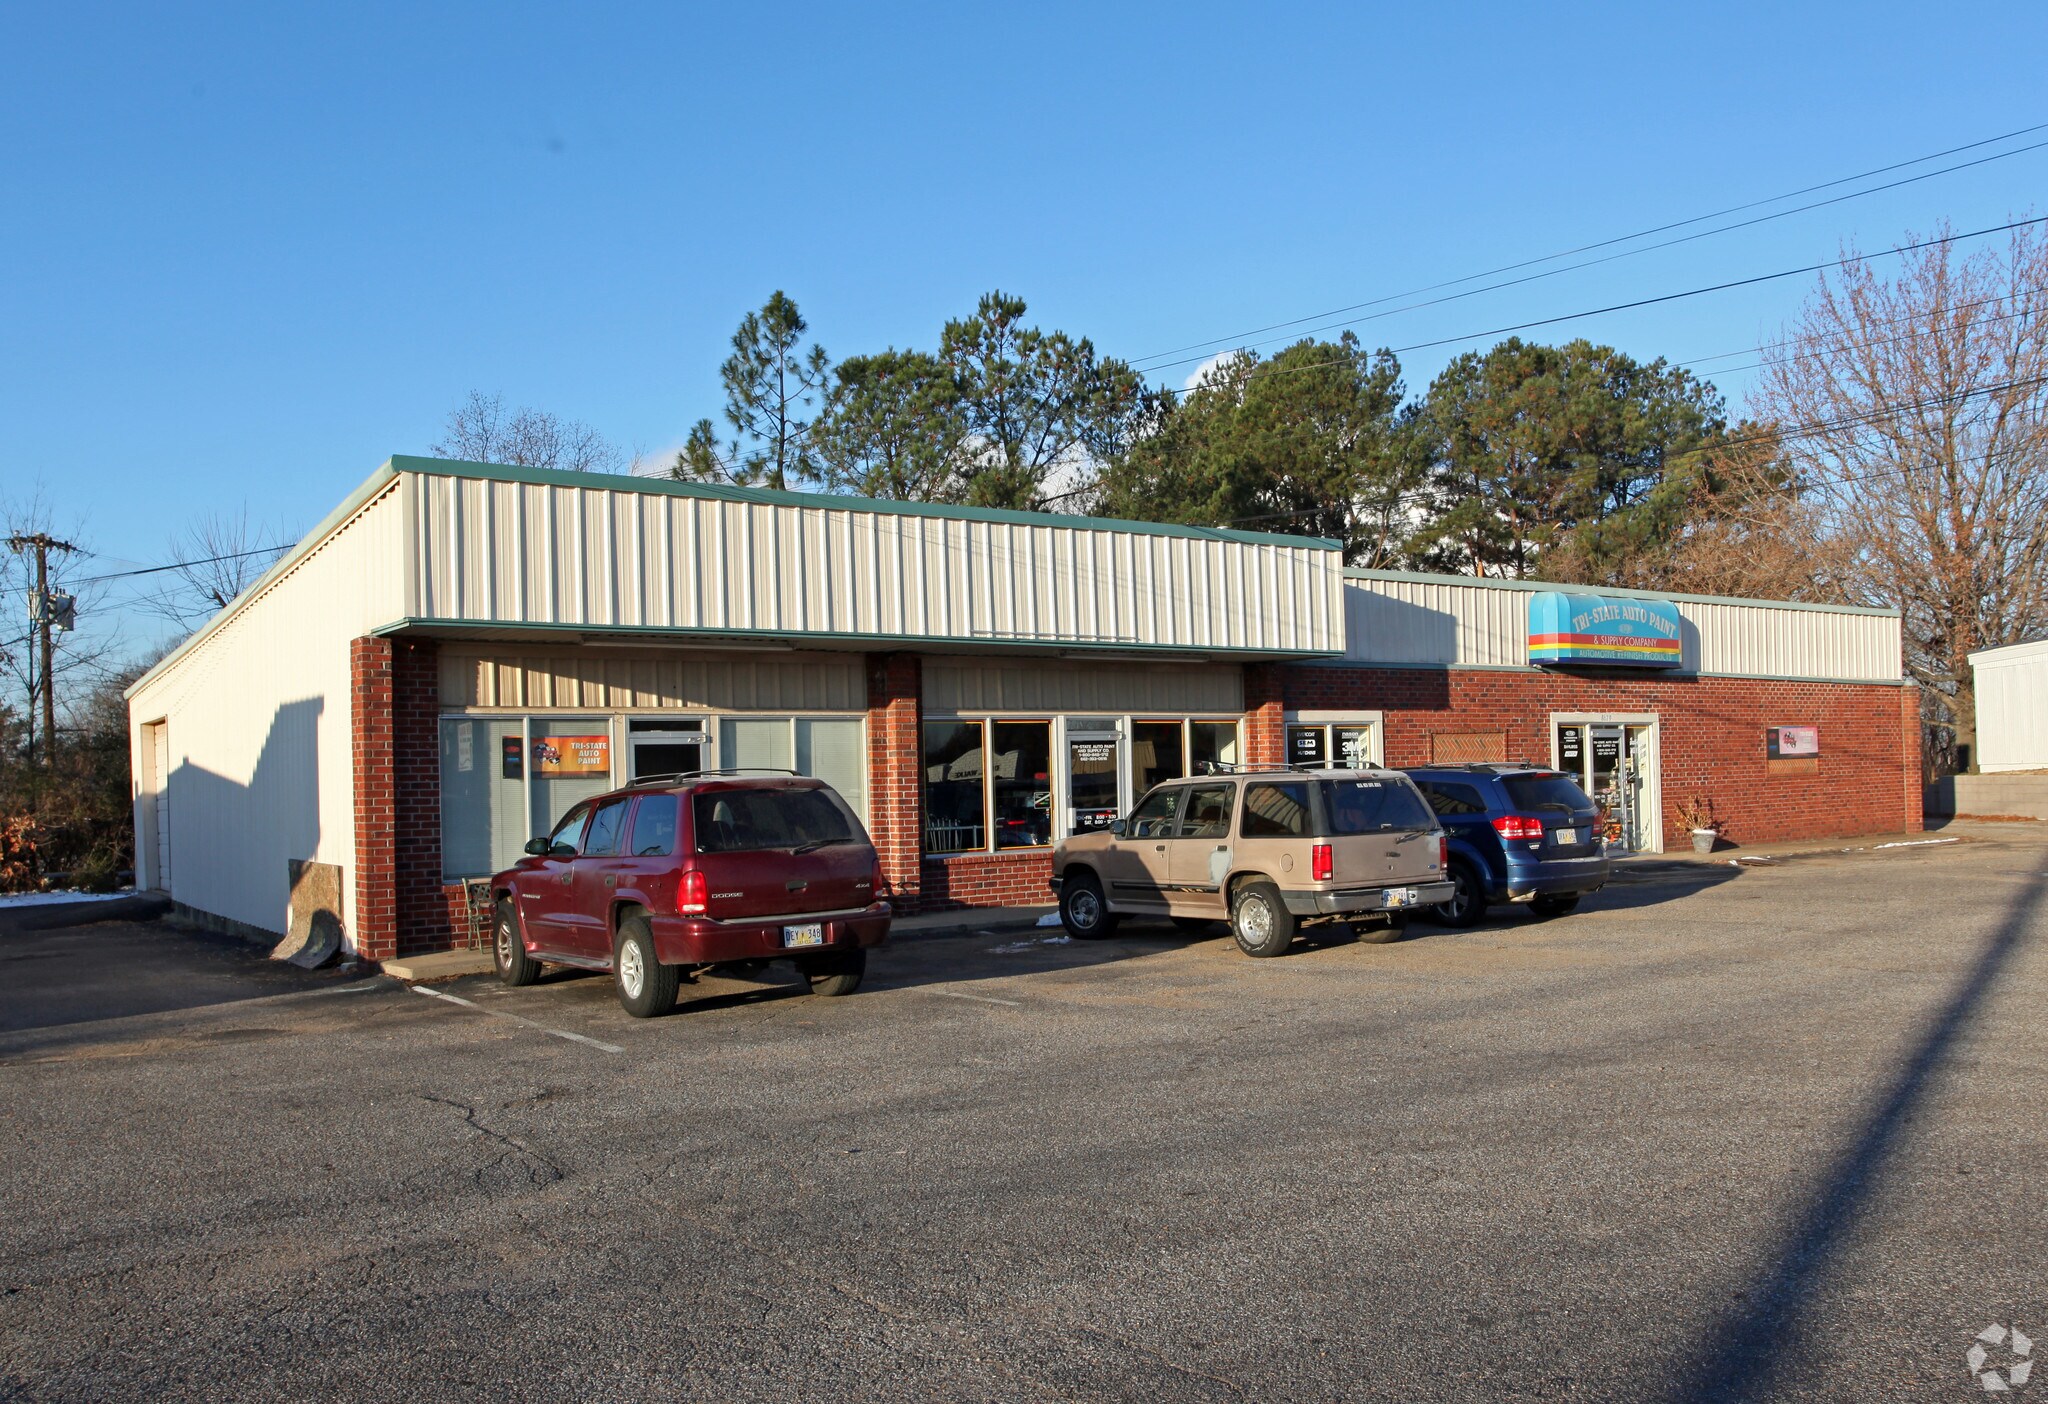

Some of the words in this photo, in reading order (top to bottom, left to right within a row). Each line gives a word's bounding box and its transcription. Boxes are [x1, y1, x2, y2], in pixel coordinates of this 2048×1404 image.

[1573, 605, 1620, 633] TRI-STATE
[1623, 606, 1647, 623] AUTO
[1650, 611, 1676, 638] PAINT
[1594, 635, 1599, 645] &
[1601, 636, 1623, 646] SUPPLY
[1624, 636, 1658, 648] COMPANY
[1579, 650, 1615, 659] AUTOMOTIVE
[1645, 652, 1672, 662] PRODUCTS
[1342, 742, 1359, 752] 3M
[808, 928, 821, 939] 348
